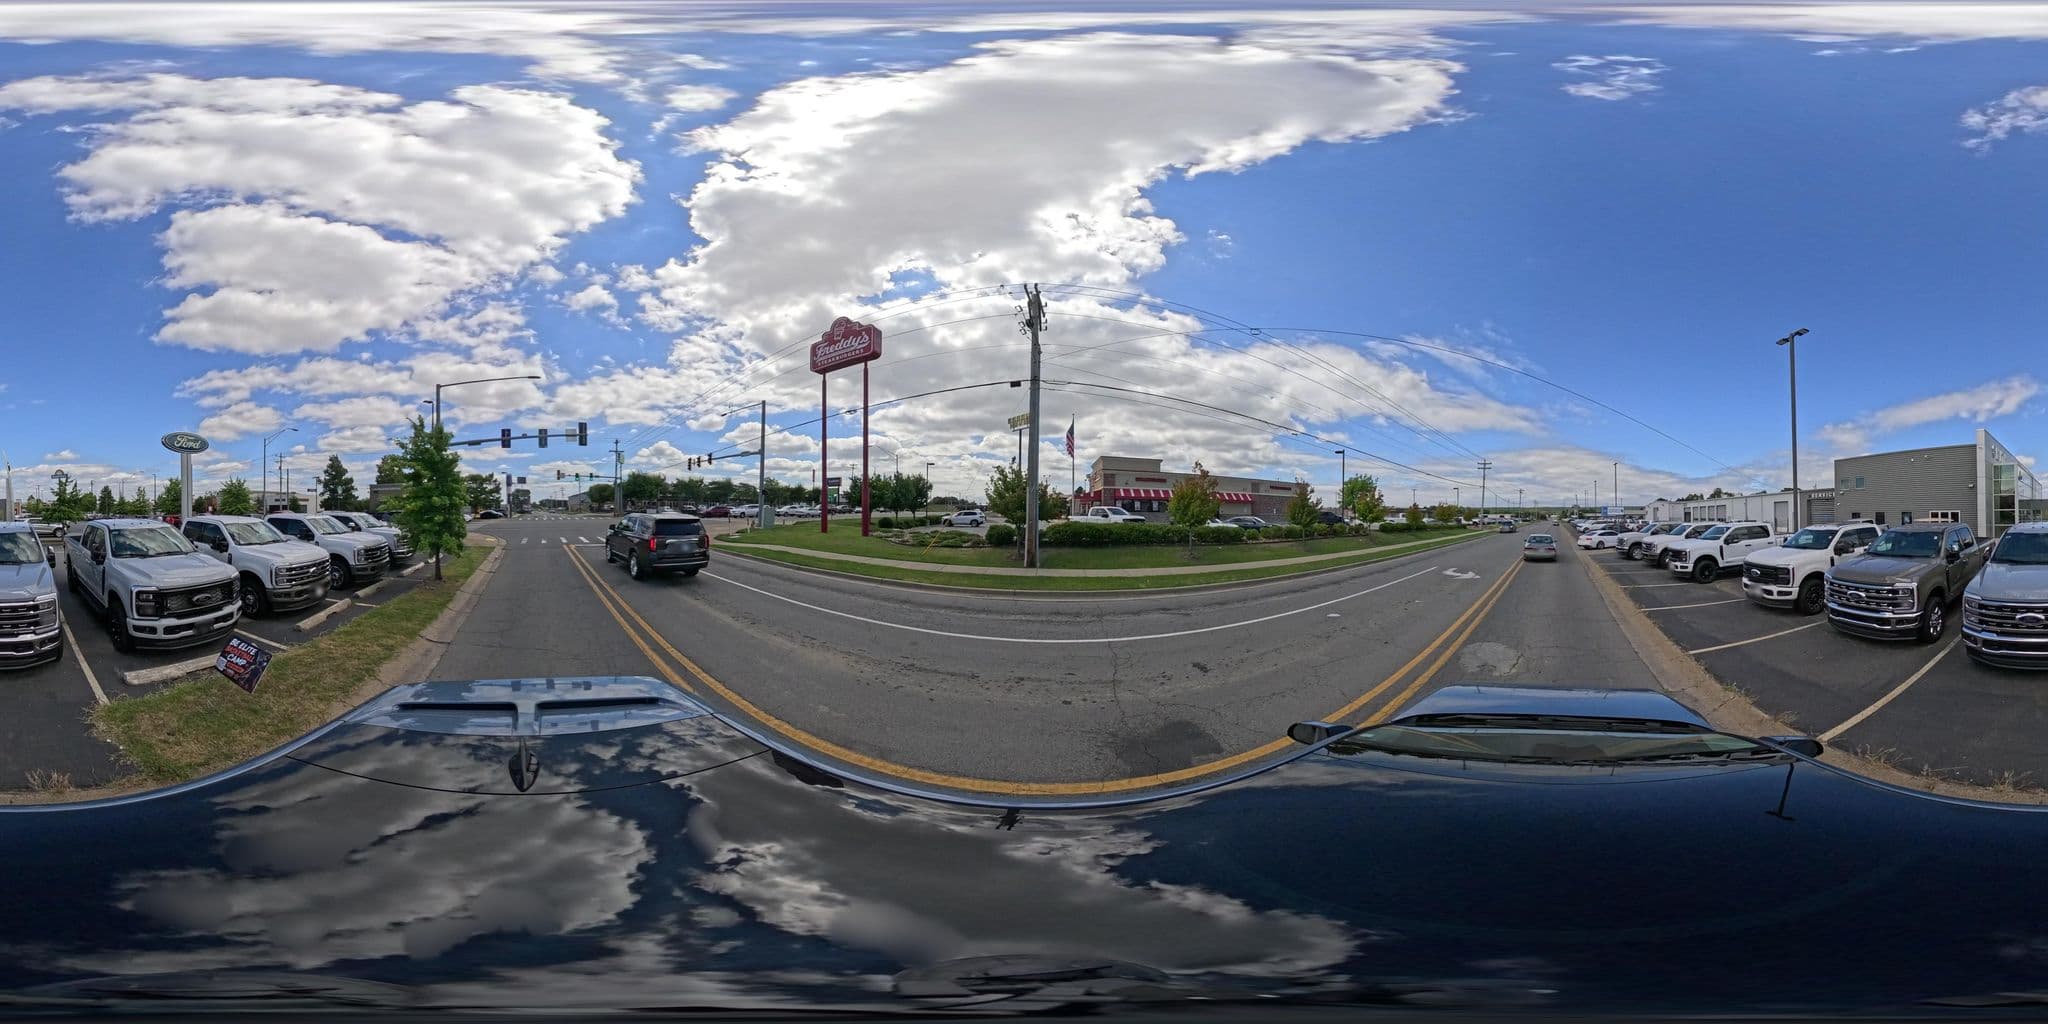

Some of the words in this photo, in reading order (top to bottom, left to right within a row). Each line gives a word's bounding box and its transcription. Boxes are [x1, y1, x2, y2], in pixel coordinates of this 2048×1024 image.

[815, 332, 870, 359] Freddy's
[816, 349, 864, 366] STEAKBURGERS
[174, 435, 201, 449] Ford
[229, 638, 240, 647] BE
[238, 642, 258, 656] ELITE
[226, 653, 248, 666] CAMP
